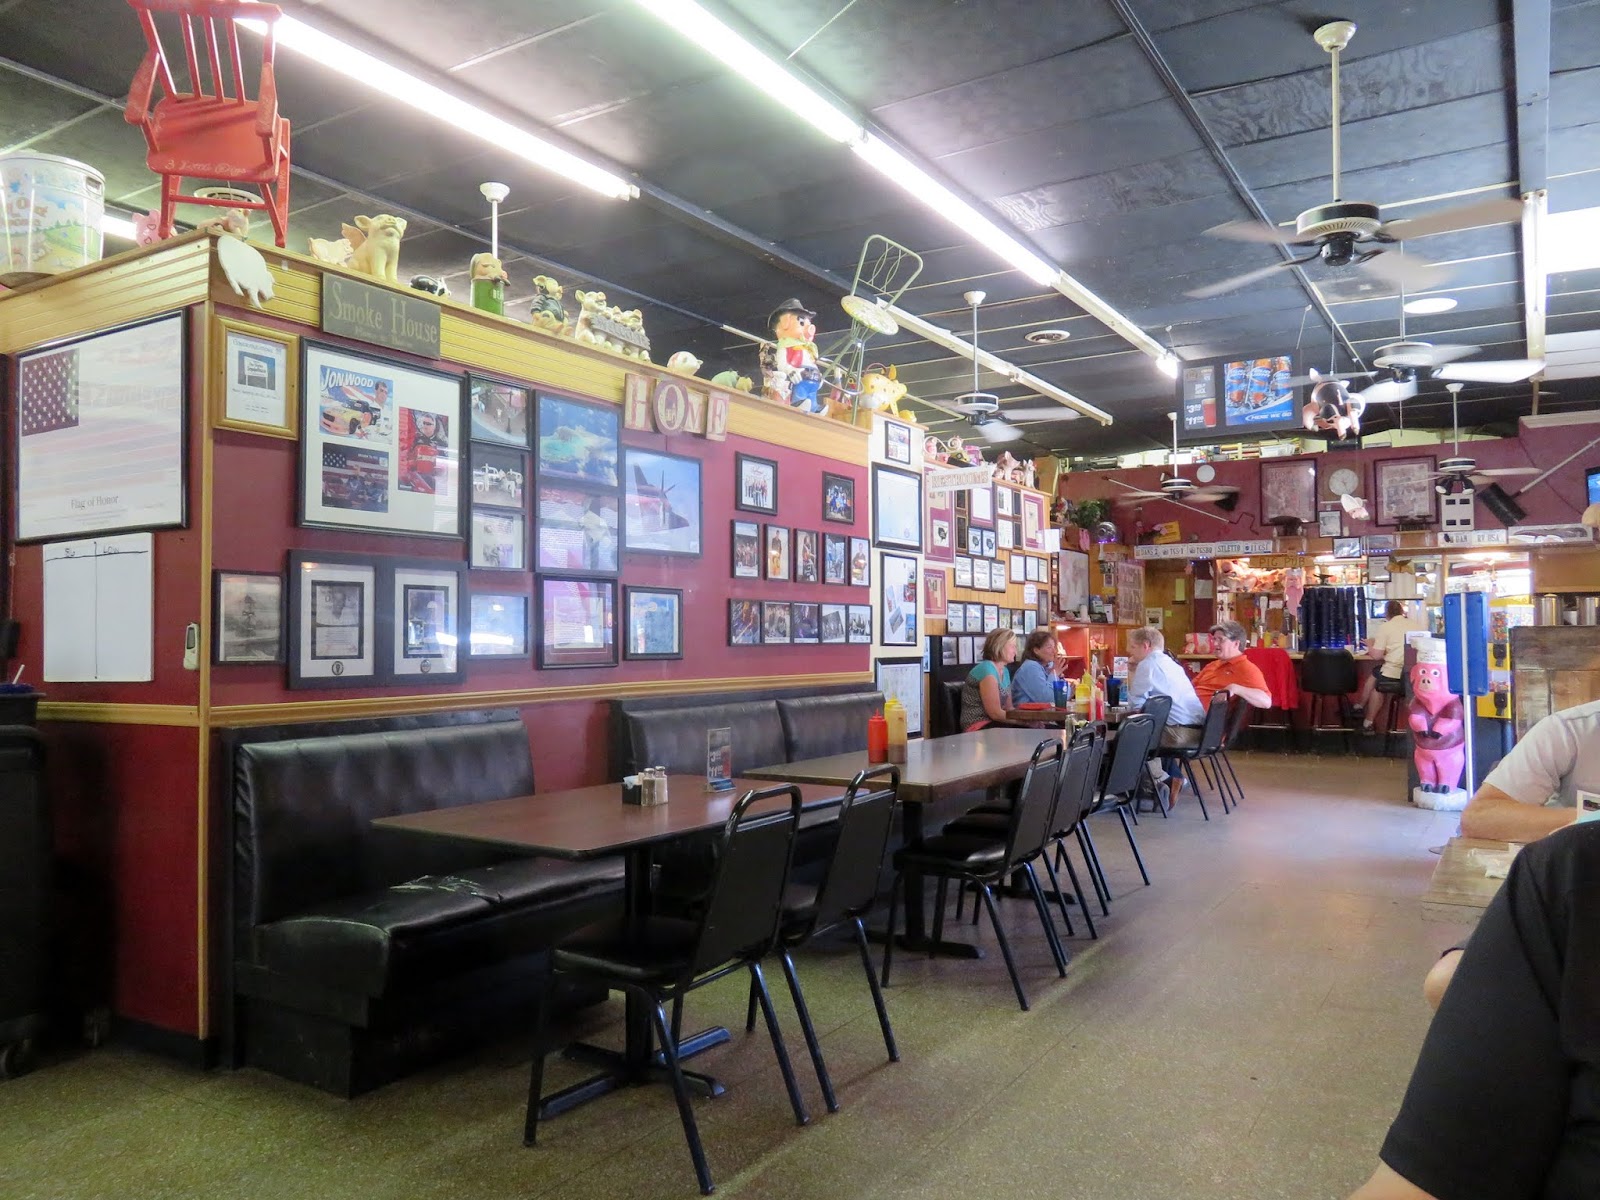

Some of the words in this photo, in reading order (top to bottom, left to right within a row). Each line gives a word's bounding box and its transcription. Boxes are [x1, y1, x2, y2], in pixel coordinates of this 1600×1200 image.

[329, 280, 383, 330] Smoke
[391, 297, 439, 345] House
[320, 367, 344, 391] JON
[343, 374, 374, 388] WOOD
[70, 498, 86, 510] Flag
[87, 497, 95, 508] of
[96, 495, 119, 506] Honor
[1259, 556, 1278, 568] PIG
[1284, 555, 1306, 568] PUB
